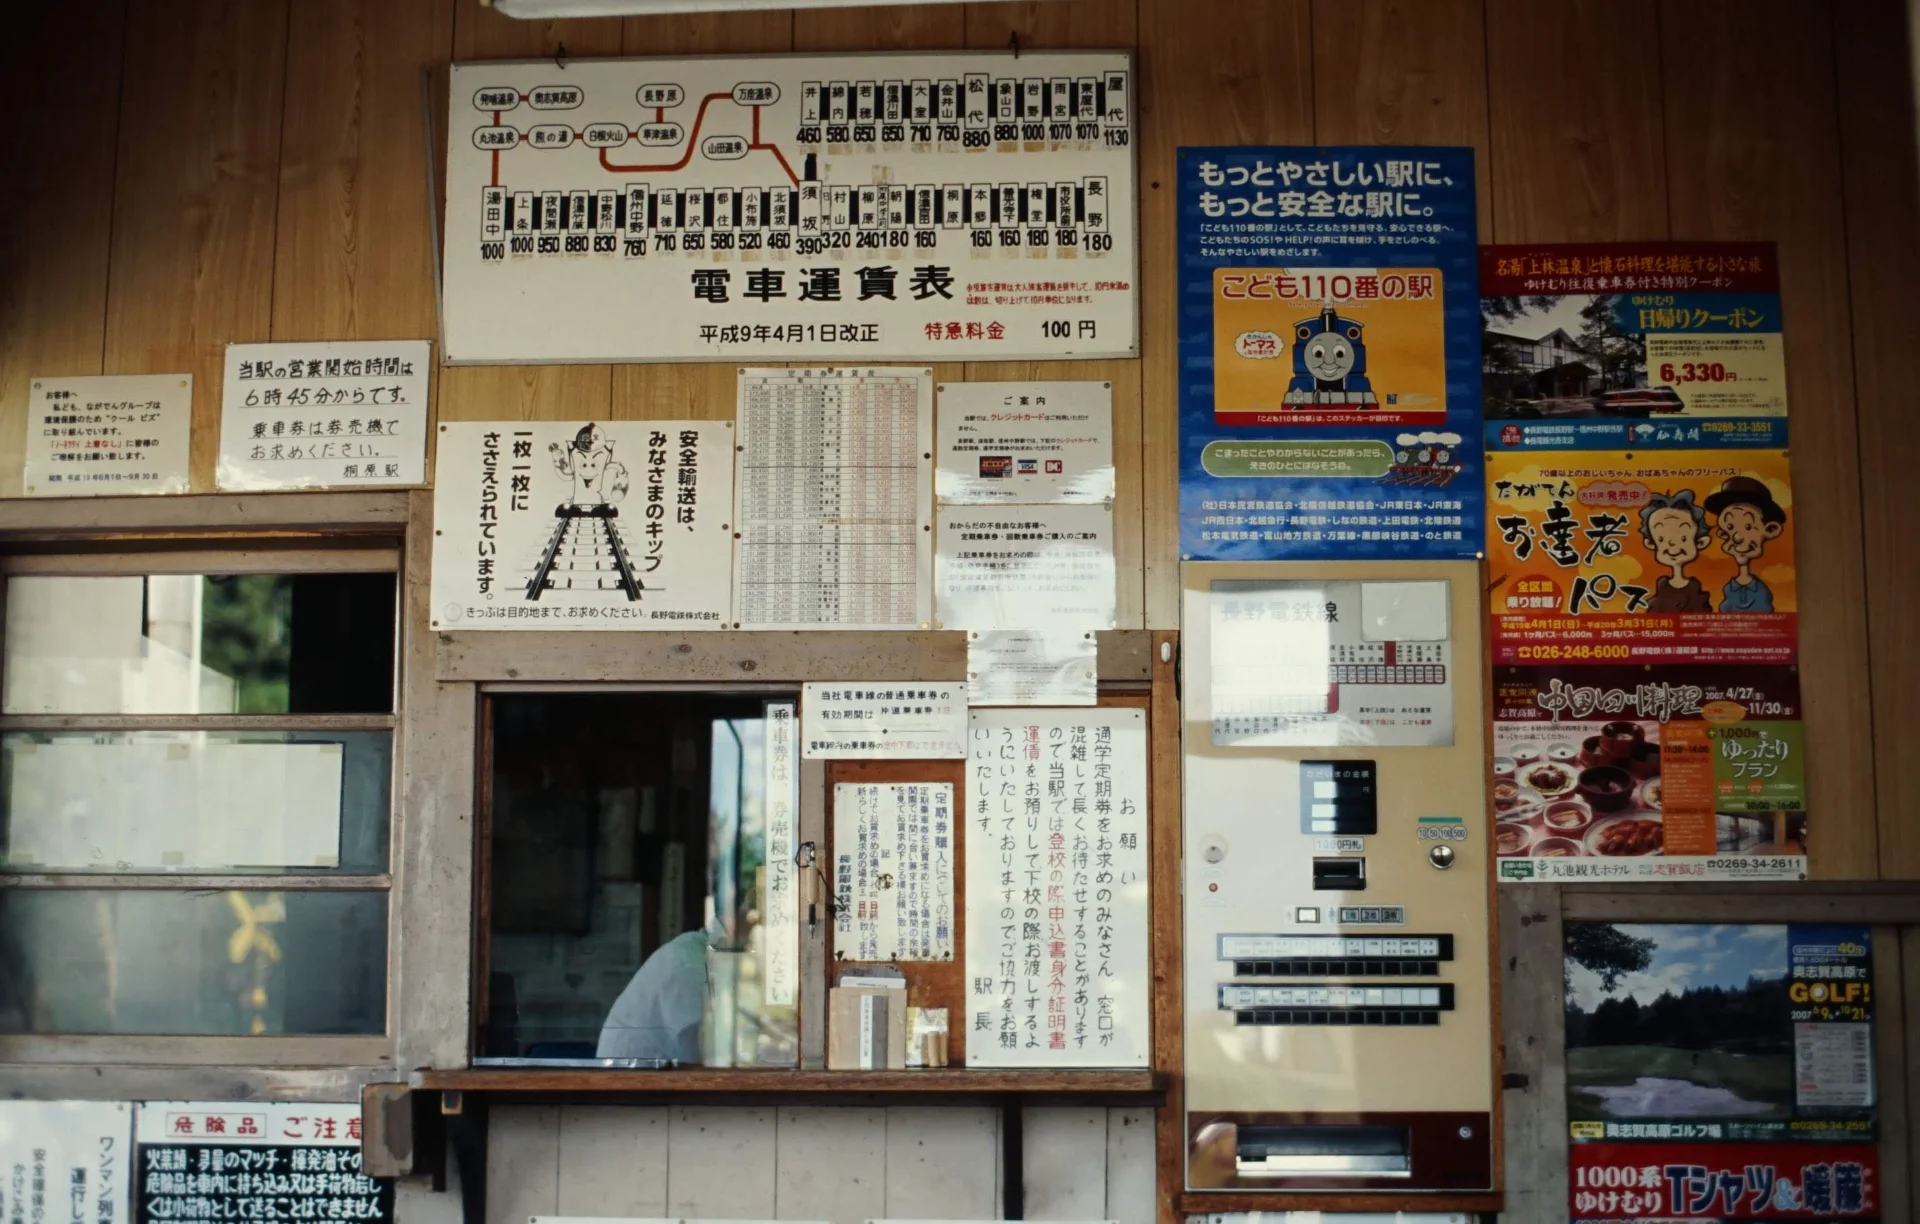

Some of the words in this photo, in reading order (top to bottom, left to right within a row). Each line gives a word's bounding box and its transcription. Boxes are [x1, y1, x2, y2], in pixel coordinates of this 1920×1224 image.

[804, 87, 818, 120] 井上
[914, 85, 927, 118] 大室
[941, 84, 954, 118] 金井山
[968, 79, 984, 123] 松代
[1027, 83, 1039, 117] 岩野
[1054, 83, 1067, 117] 雨宮
[1080, 83, 1094, 117] 東屋代
[1107, 77, 1124, 122] 屋代
[708, 141, 744, 154] 山田温泉
[826, 126, 849, 142] 580
[881, 125, 905, 142] 650
[936, 125, 960, 141] 760
[994, 124, 1019, 141] 880
[1049, 123, 1072, 140] 1070
[1104, 129, 1128, 146] 1130
[1199, 161, 1453, 188] もっとやさしい駅に、
[486, 191, 502, 236] 湯田中
[517, 196, 529, 231] 上条
[629, 189, 645, 234] 信州中野
[688, 193, 701, 227] 桜沢
[716, 193, 729, 227] 都住
[745, 193, 758, 226] 小布施
[773, 192, 786, 226] 北須坂
[802, 186, 818, 231] 須坂
[834, 191, 846, 225] 村山
[947, 189, 959, 224] 桐原
[1087, 181, 1103, 227] 長野
[1199, 191, 1434, 218] もっと安全な駅に。
[510, 236, 534, 253] 1000
[565, 236, 589, 252] 880
[624, 240, 646, 256] 760
[683, 233, 705, 250] 650
[739, 233, 762, 250] 520
[796, 238, 822, 255] 390
[856, 232, 879, 248] 240
[914, 231, 936, 247] 160
[999, 230, 1021, 246] 160
[1055, 229, 1077, 246] 180
[691, 265, 955, 304] 電車運賃表
[1222, 274, 1434, 300] こども110番の駅
[700, 323, 879, 343] 平成9年4月1日改正
[924, 321, 1006, 340] 特急料金
[1042, 320, 1071, 338] 100
[1078, 320, 1096, 339] 円
[1639, 307, 1766, 330] 日帰りクーポン
[1243, 339, 1276, 349] トーマス
[238, 357, 414, 379] 当駅の営業開始時間は
[1660, 363, 1737, 385] 6,330円
[45, 391, 78, 400] お客様へ
[244, 386, 406, 406] 6時45分からです。
[1003, 396, 1046, 406] ご案内
[250, 444, 380, 460] お求めください。
[1249, 461, 1352, 471] えきのひとにはなそうね。
[343, 463, 400, 477] 桐原駅
[510, 430, 533, 512] 一枚一枚に
[677, 429, 699, 532] 安全輸送は、
[476, 431, 501, 601] ささえられています。
[645, 430, 667, 573] みなさまのキップ
[1495, 500, 1631, 568] お達者
[1517, 582, 1553, 593] 全区間
[1569, 574, 1650, 615] パス
[1533, 646, 1629, 659] 026-248-6000
[821, 690, 950, 700] 当社電車線の普通乗車券の
[821, 710, 873, 720] 有効期間は
[1721, 739, 1789, 761] ゆったり
[1732, 763, 1778, 778] プラン
[1119, 798, 1138, 885] お願い
[1453, 829, 1465, 838] 500
[1094, 726, 1114, 977] 通学定期券をお求めのみなさん
[1071, 726, 1090, 1048] 混雑して長くお待たせすることがあります
[974, 977, 993, 1031] 駅長
[1789, 982, 1871, 1002] GOLF!
[1097, 994, 1115, 1046] 窓口が
[174, 1116, 258, 1134] 危険品
[1576, 1166, 1662, 1189] 1000系
[71, 1167, 87, 1224] 運行し
[1575, 1191, 1661, 1212] ゆけむり
